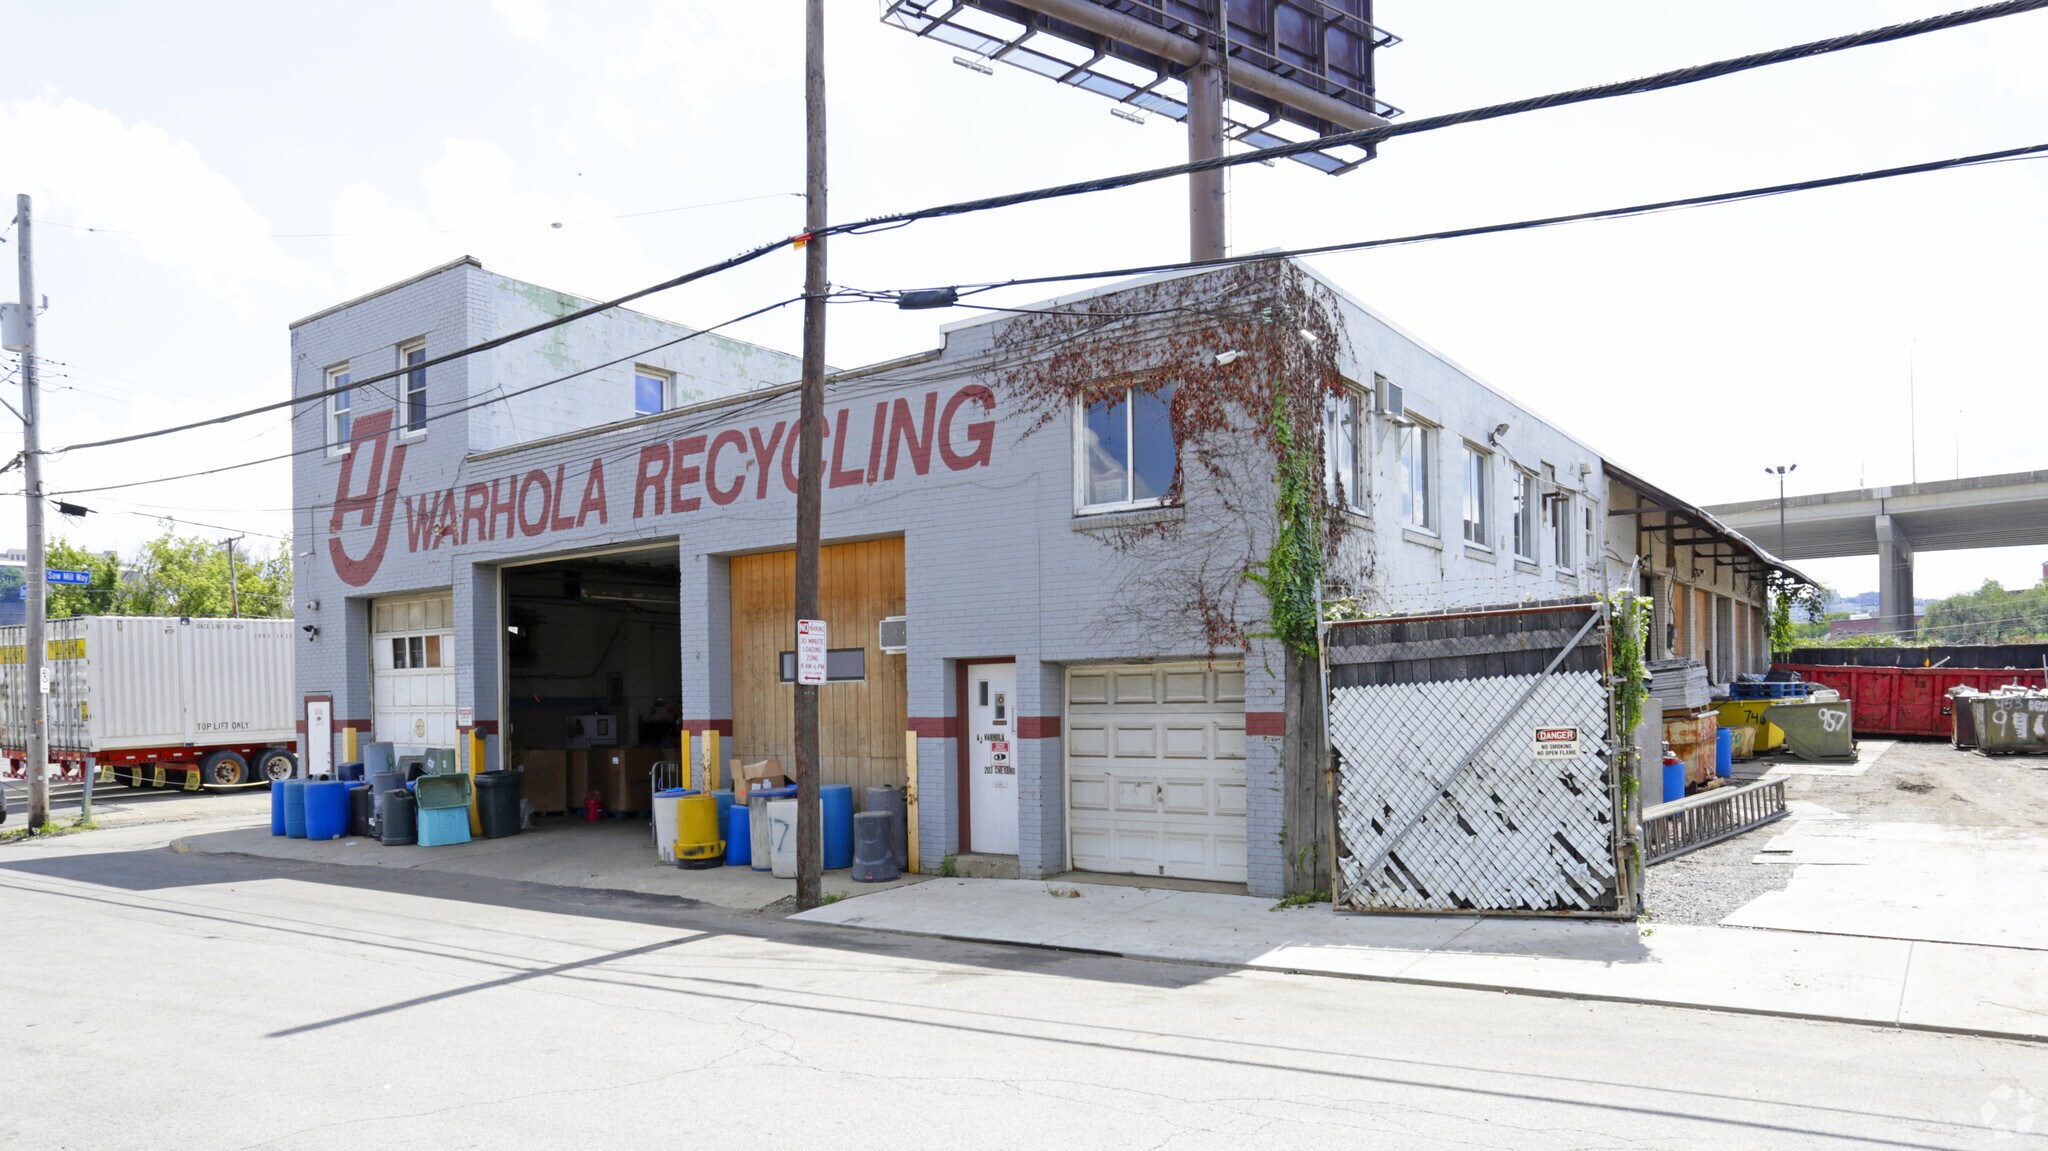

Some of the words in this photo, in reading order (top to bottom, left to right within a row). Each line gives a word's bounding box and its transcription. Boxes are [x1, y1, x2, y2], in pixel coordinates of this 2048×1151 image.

[406, 457, 608, 553] WARHOLA
[632, 383, 996, 519] RECYCLING
[47, 571, 61, 580] Saw
[63, 572, 74, 580] Mill
[76, 573, 89, 583] Way
[808, 638, 824, 646] MINUTE
[1818, 707, 1847, 732] 957
[197, 722, 212, 731] TOP
[213, 722, 228, 730] LIFT
[231, 721, 249, 730] ONLY
[1540, 731, 1573, 740] DANGER
